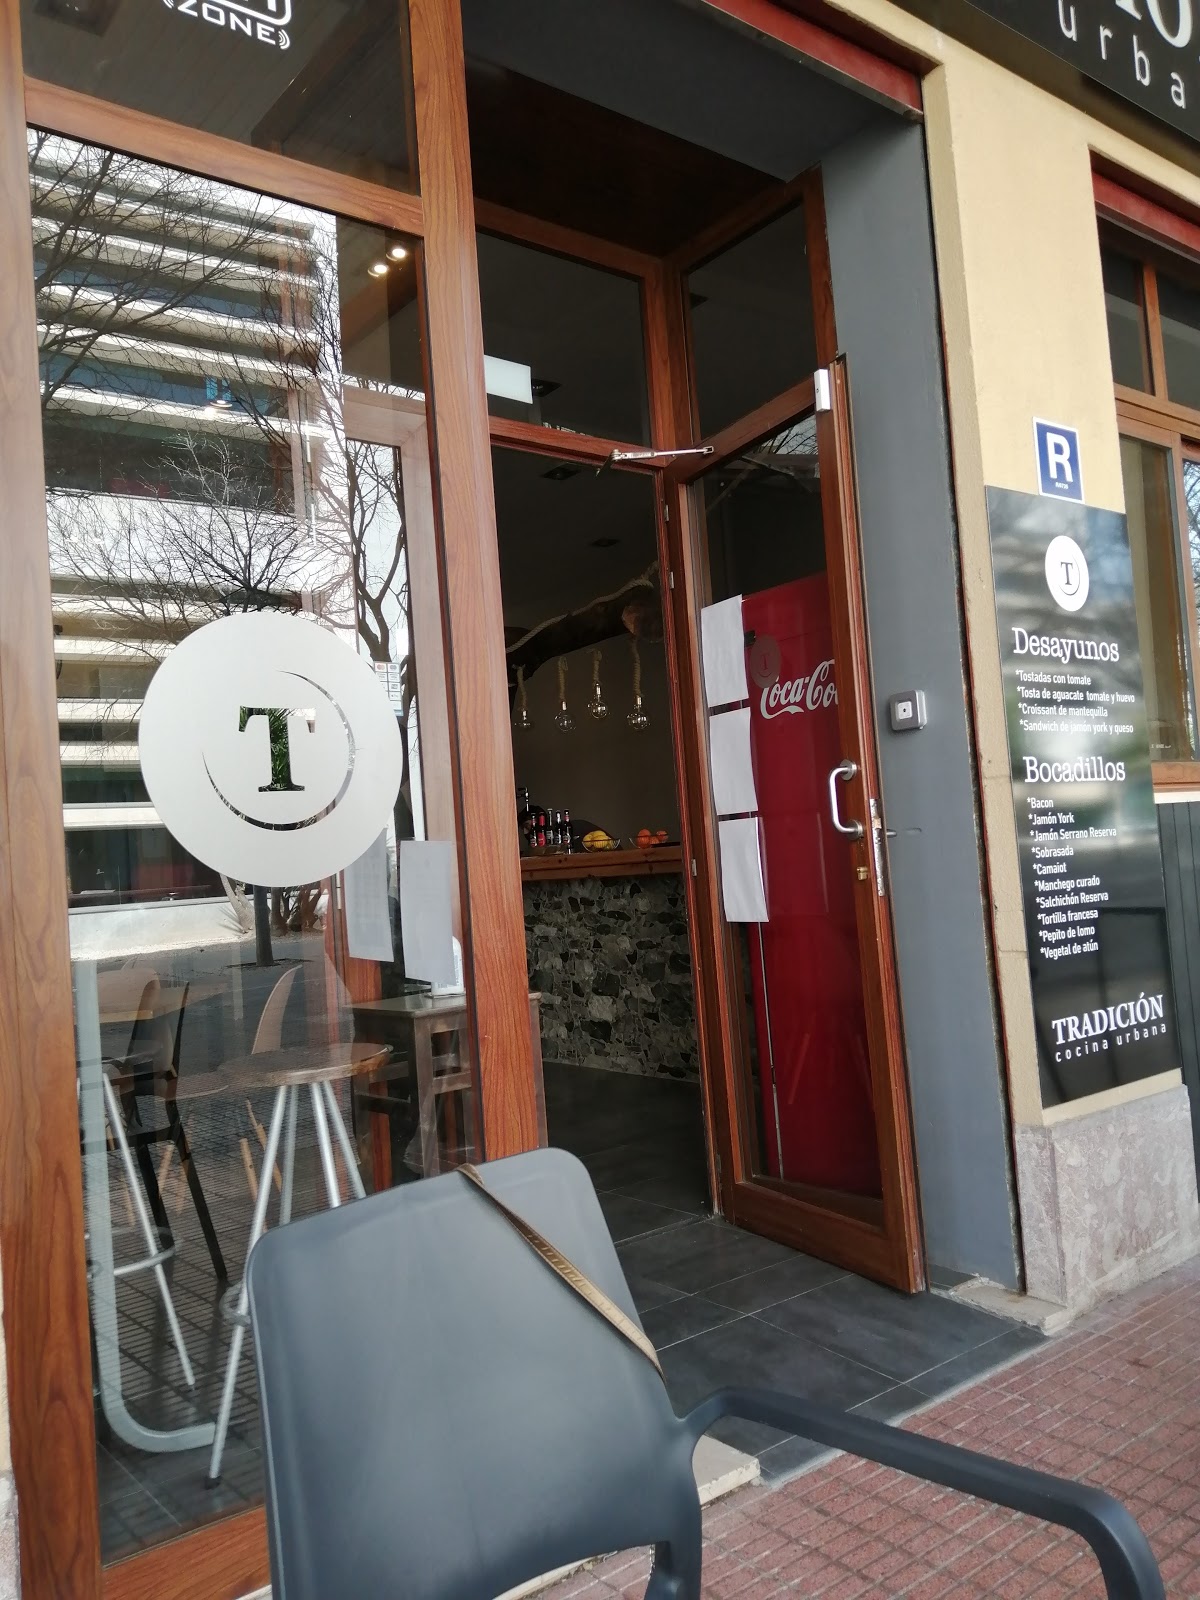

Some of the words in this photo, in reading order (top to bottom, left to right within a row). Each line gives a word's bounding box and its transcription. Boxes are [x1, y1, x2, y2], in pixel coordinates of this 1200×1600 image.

[177, 0, 276, 45] ZONE
[1046, 432, 1074, 482] R
[1060, 561, 1074, 586] T
[1012, 627, 1120, 664] Desayunos
[1053, 674, 1066, 684] con
[1067, 674, 1091, 685] tomate
[1042, 688, 1051, 699] de
[1052, 690, 1084, 702] aguacate
[1086, 691, 1109, 702] tomate
[1111, 694, 1115, 704] y
[1116, 692, 1135, 703] huevo
[1058, 705, 1067, 716] de
[1068, 706, 1108, 719] mantequilla
[1061, 721, 1069, 732] de
[1070, 721, 1091, 734] jamón
[1092, 722, 1108, 735] york
[1109, 725, 1114, 735] y
[1115, 724, 1133, 735] queso
[238, 705, 317, 792] T
[1022, 756, 1126, 783] Bocadillos
[1057, 812, 1075, 824] York
[1059, 829, 1088, 840] Serrano
[1089, 827, 1117, 838] Reserva
[1076, 875, 1100, 887] curado
[1080, 892, 1109, 904] Reserva
[1067, 909, 1098, 922] francesa
[1066, 926, 1076, 938] de
[1077, 925, 1095, 937] lomo
[1072, 943, 1081, 954] de
[1082, 939, 1098, 952] atún
[1051, 992, 1164, 1045] TRADICIÓN
[1055, 1039, 1109, 1063] cocina
[1116, 1023, 1167, 1046] urbana
